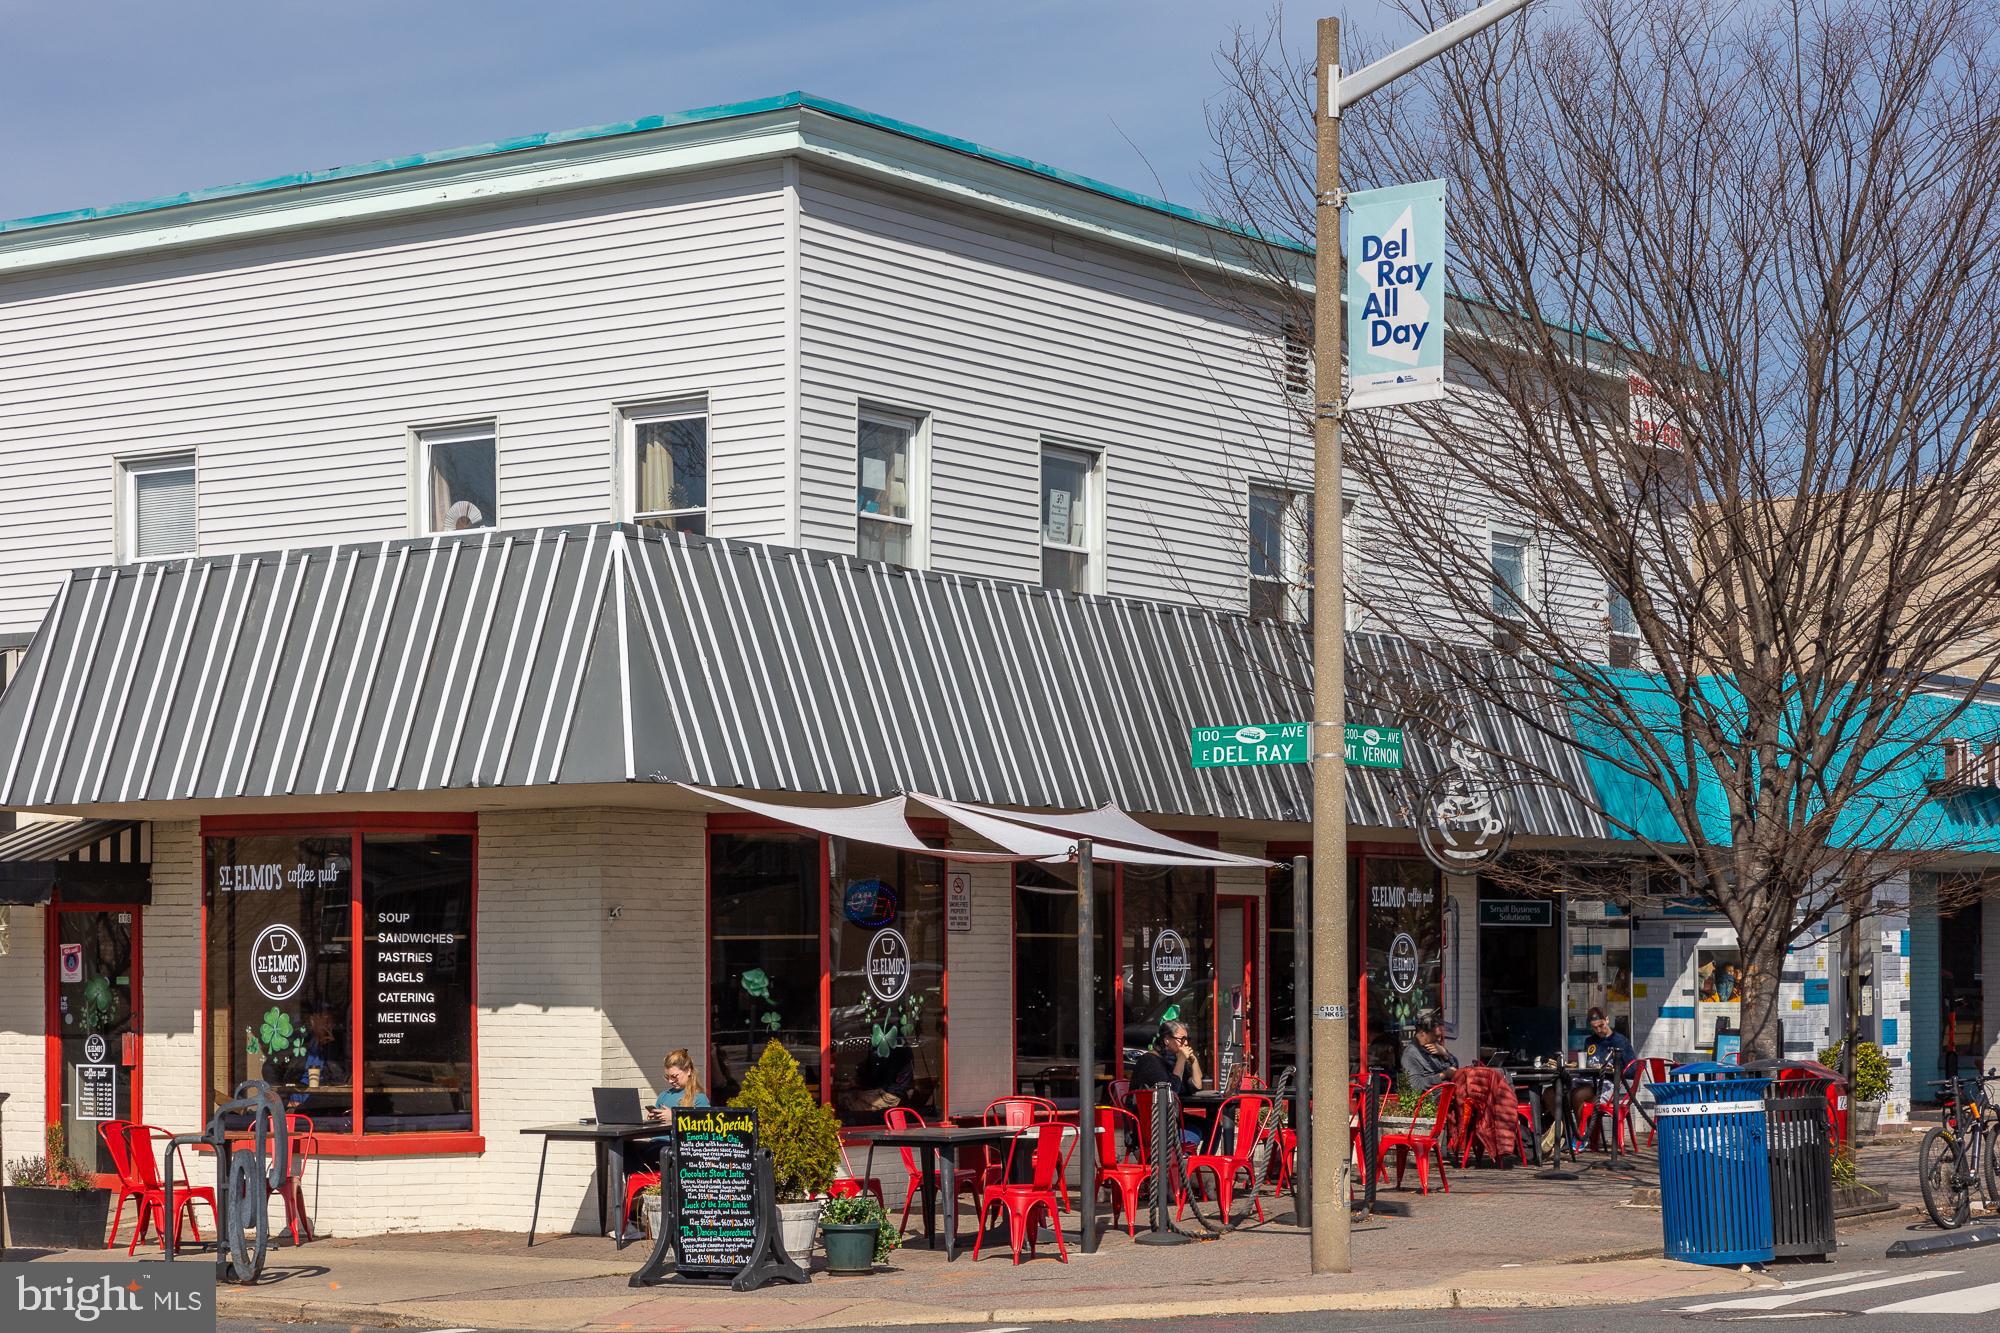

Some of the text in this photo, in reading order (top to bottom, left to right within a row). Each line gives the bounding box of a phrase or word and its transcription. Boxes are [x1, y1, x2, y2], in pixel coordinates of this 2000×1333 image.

[1362, 228, 1407, 262] Del
[1377, 260, 1433, 290] Ray
[1361, 287, 1398, 321] All
[1371, 319, 1429, 350] Day
[1198, 725, 1304, 742] 100 AVE
[1387, 732, 1400, 744] AVE
[1202, 743, 1293, 763] E DEL RAY
[1344, 743, 1399, 764] MT. VERNON
[1954, 738, 1989, 787] The
[219, 862, 340, 891] ST. ELMO'S coffee pub
[1380, 886, 1406, 908] ELMO'S
[1407, 887, 1422, 907] coffee
[1423, 887, 1435, 907] pub
[1489, 904, 1541, 913] Small Business
[378, 912, 410, 923] SOUP
[1499, 913, 1531, 921] Solutions
[378, 933, 454, 944] SANDWICHES
[258, 954, 300, 973] ST. ELMO'S
[378, 952, 433, 963] PASTRIES
[1398, 957, 1415, 971] ELMO'S
[880, 958, 905, 975] ELMO'S
[378, 972, 424, 983] BAGELS
[378, 992, 435, 1003] CATERING
[377, 1012, 436, 1023] MEETINGS
[84, 1067, 107, 1080] coffee pub
[677, 1112, 754, 1137] March Specials
[686, 1132, 708, 1141] Emerald
[712, 1132, 723, 1141] Isle
[680, 1168, 744, 1179] Chocolate Stout Latte
[684, 1199, 699, 1208] Luck
[707, 1200, 716, 1208] the
[717, 1200, 731, 1208] Irish
[732, 1200, 748, 1208] Latte
[680, 1225, 752, 1237] The Dancing Leprechaun
